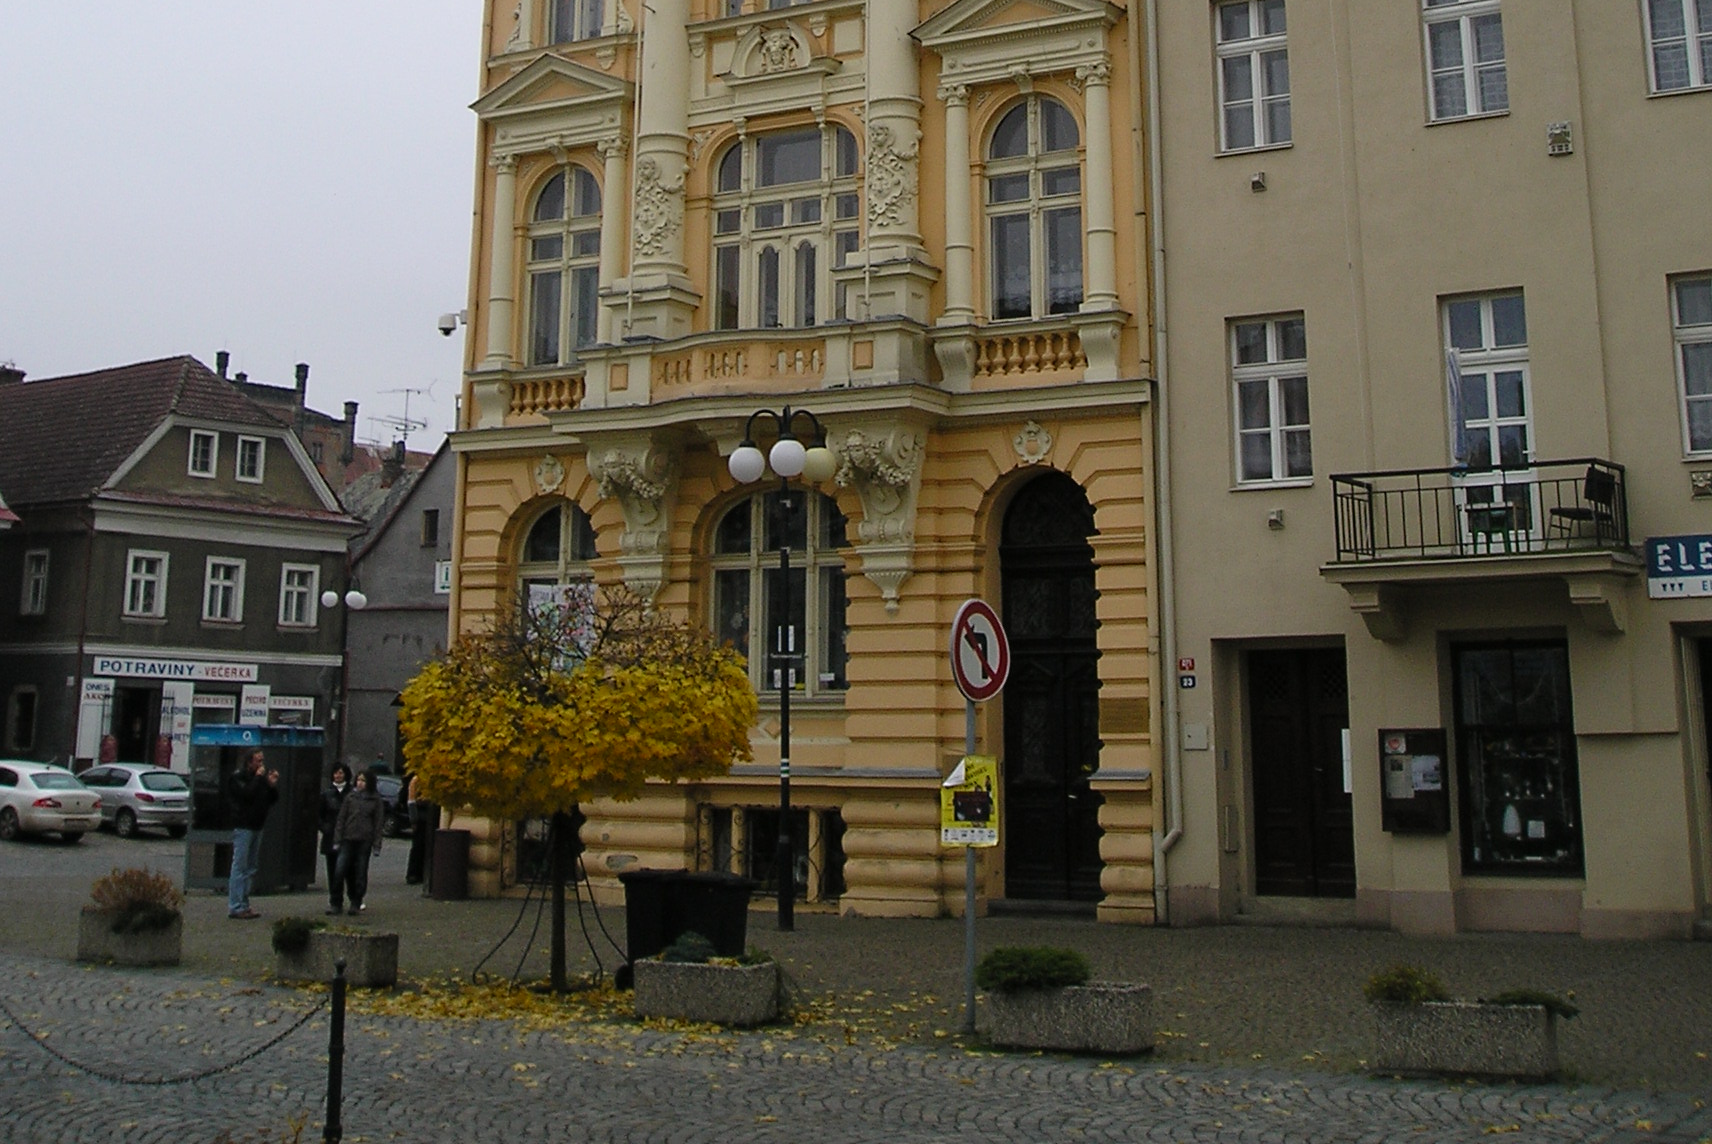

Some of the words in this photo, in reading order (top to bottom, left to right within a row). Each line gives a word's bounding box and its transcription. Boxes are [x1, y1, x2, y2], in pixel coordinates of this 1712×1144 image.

[100, 660, 195, 676] POTRAVINY
[204, 665, 251, 678] VEČERKA
[1182, 677, 1193, 687] 23
